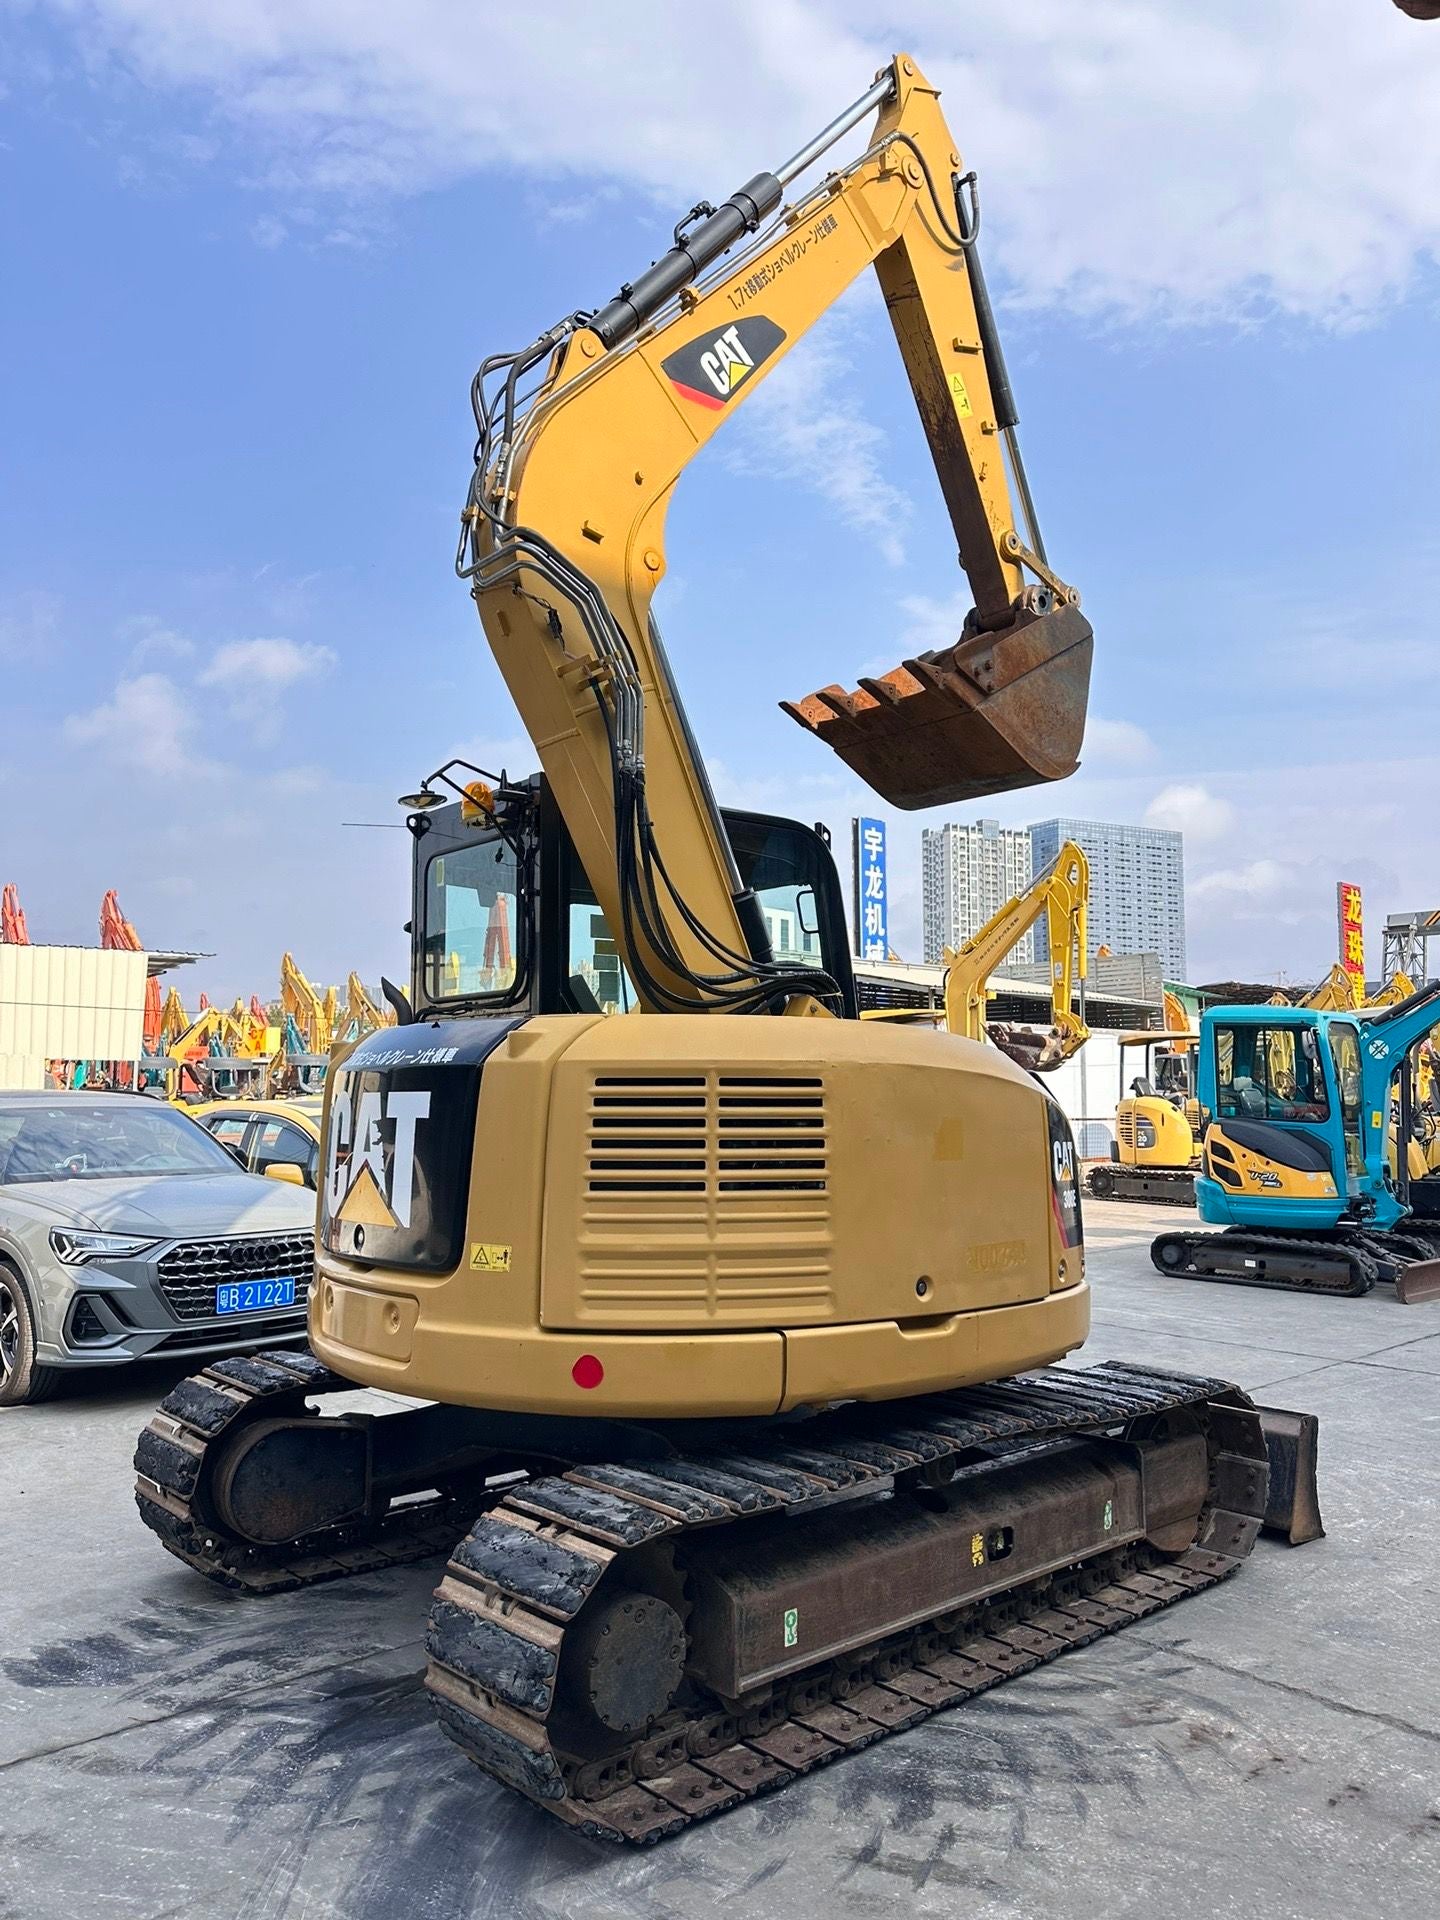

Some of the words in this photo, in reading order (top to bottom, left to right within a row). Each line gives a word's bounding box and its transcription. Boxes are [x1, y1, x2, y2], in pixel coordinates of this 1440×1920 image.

[727, 213, 838, 310] 1.7t移動式ショベルクレーン仕様車
[700, 325, 754, 395] CAT
[328, 1091, 431, 1229] CAT
[1053, 1140, 1074, 1182] CAT
